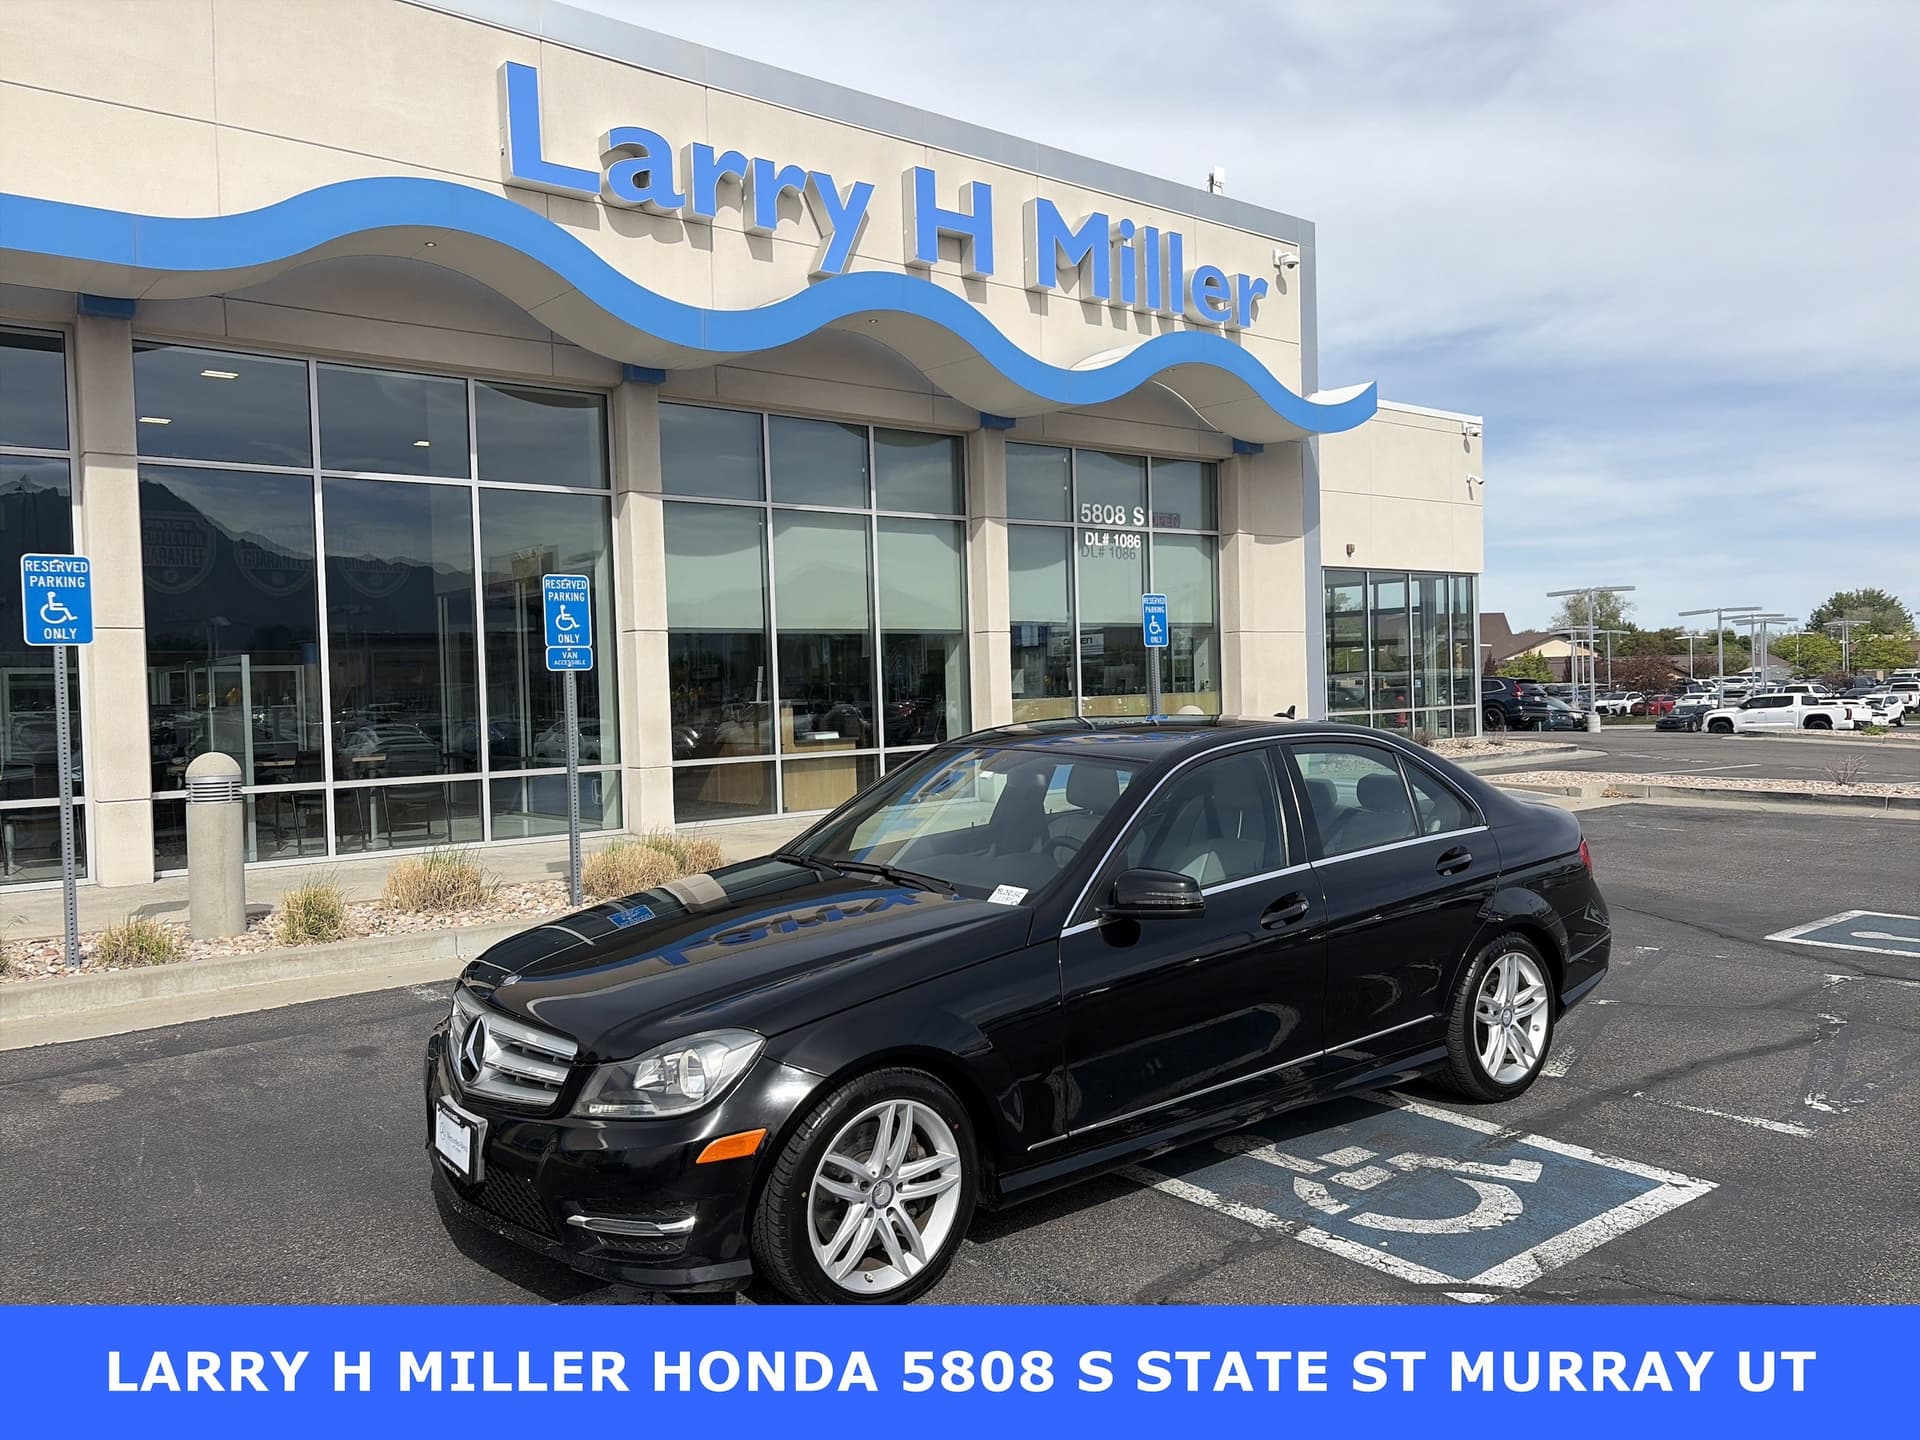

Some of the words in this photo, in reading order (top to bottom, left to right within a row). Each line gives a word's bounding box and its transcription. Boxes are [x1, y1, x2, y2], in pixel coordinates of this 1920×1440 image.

[501, 60, 875, 276] Larry
[907, 165, 995, 278] H
[1028, 196, 1270, 331] Miller
[1080, 503, 1127, 525] 5808
[1132, 506, 1145, 526] S
[1084, 531, 1110, 546] DL#
[1113, 533, 1142, 549] 1086
[24, 559, 89, 574] RESERVED
[29, 575, 87, 589] PARKING
[545, 579, 587, 590] RESERVED
[548, 591, 586, 602] PARKING
[43, 627, 78, 640] ONLY
[557, 633, 581, 644] ONLY
[561, 651, 578, 660] VAN
[553, 659, 586, 667] ACCESSIBLE
